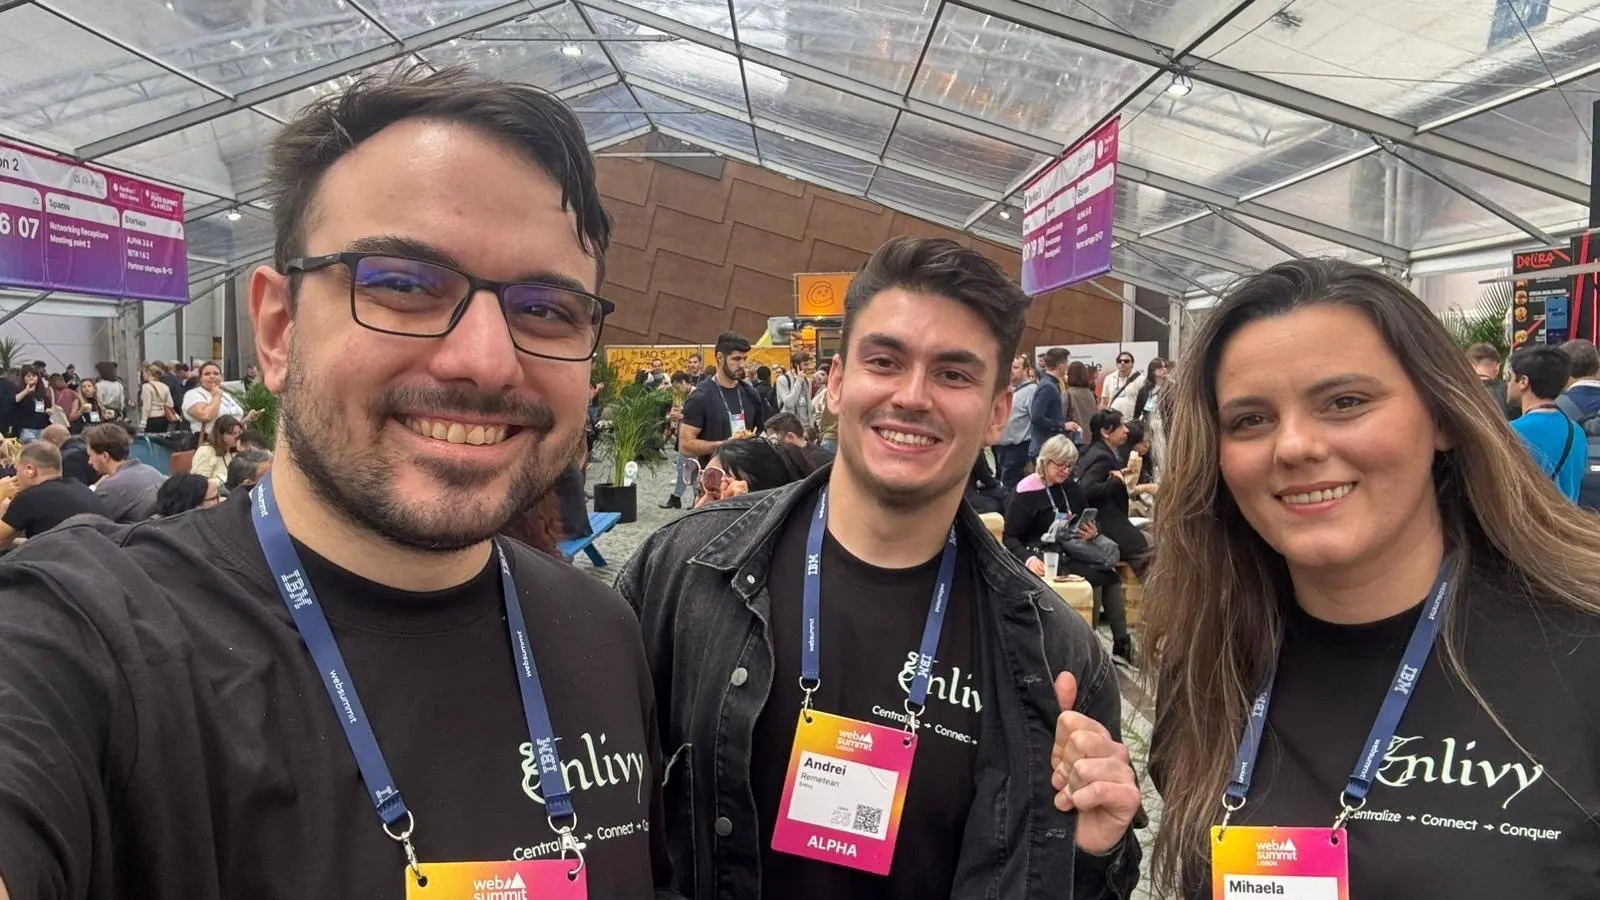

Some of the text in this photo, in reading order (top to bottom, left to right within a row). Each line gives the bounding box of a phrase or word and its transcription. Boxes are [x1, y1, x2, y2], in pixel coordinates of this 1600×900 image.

[12, 158, 20, 172] 2
[48, 199, 71, 211] Spaces
[18, 215, 40, 239] 07
[49, 221, 109, 240] Networking Receptions
[49, 234, 92, 249] Meeting point 2
[807, 553, 819, 576] IBM
[280, 569, 313, 610] IBM
[807, 618, 815, 652] websummit
[516, 630, 532, 678] websummit
[917, 653, 932, 679] IBM
[1394, 664, 1418, 695] IBM
[329, 669, 357, 724] websummit
[837, 738, 873, 752] summit
[839, 729, 860, 741] web
[536, 737, 558, 774] IBM
[1360, 739, 1381, 779] websummit
[803, 757, 847, 776] Andrei
[1375, 735, 1544, 809] Enlivy
[800, 772, 840, 787] Remetean
[596, 821, 635, 841] Connect
[1420, 813, 1479, 831] Connect
[1499, 823, 1562, 841] Conquer
[806, 835, 858, 858] ALPHA
[1256, 839, 1280, 851] web
[1256, 850, 1298, 861] summit
[472, 874, 504, 890] web
[1229, 880, 1285, 895] Mihaela
[472, 888, 528, 900] summit
